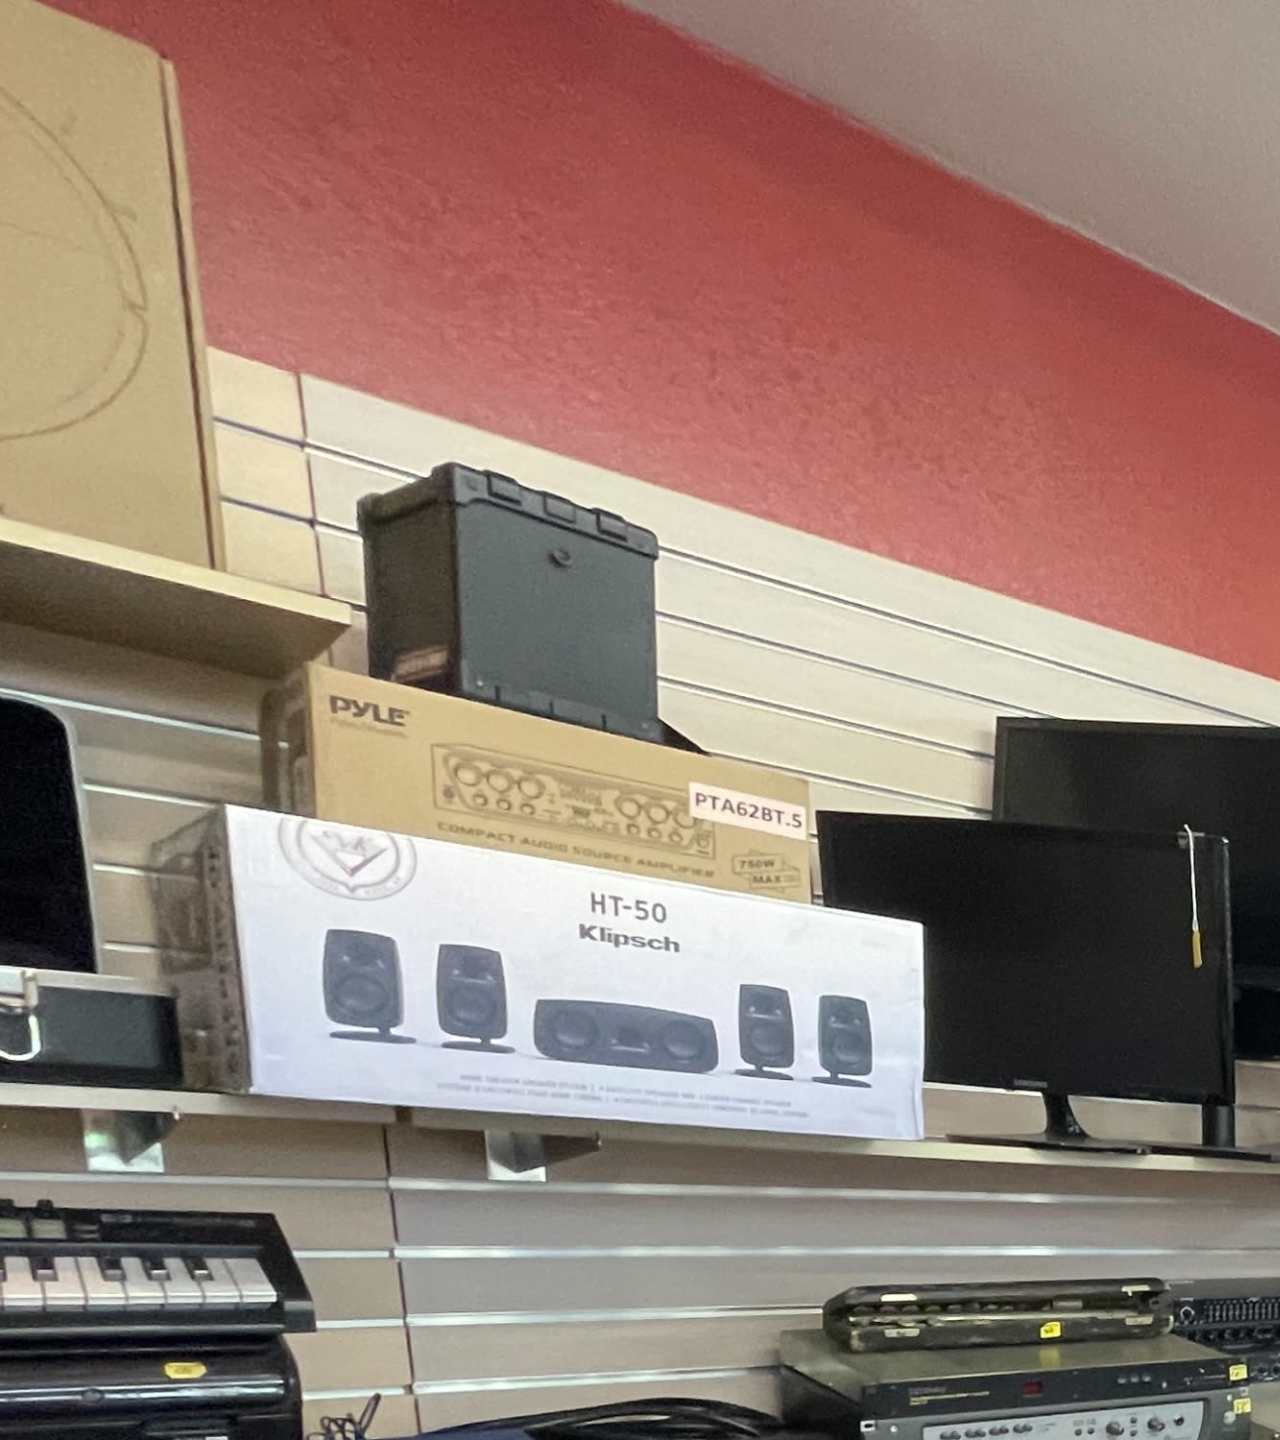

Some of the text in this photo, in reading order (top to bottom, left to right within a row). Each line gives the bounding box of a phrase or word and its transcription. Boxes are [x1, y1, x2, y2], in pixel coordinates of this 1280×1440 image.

[329, 694, 407, 727] PYLE
[694, 791, 803, 829] PTA62BT.5
[437, 822, 716, 878] COMPACT AUDIO SOURCE AMPLIFIER
[590, 892, 668, 924] HT-50
[578, 922, 681, 953] Klipsch
